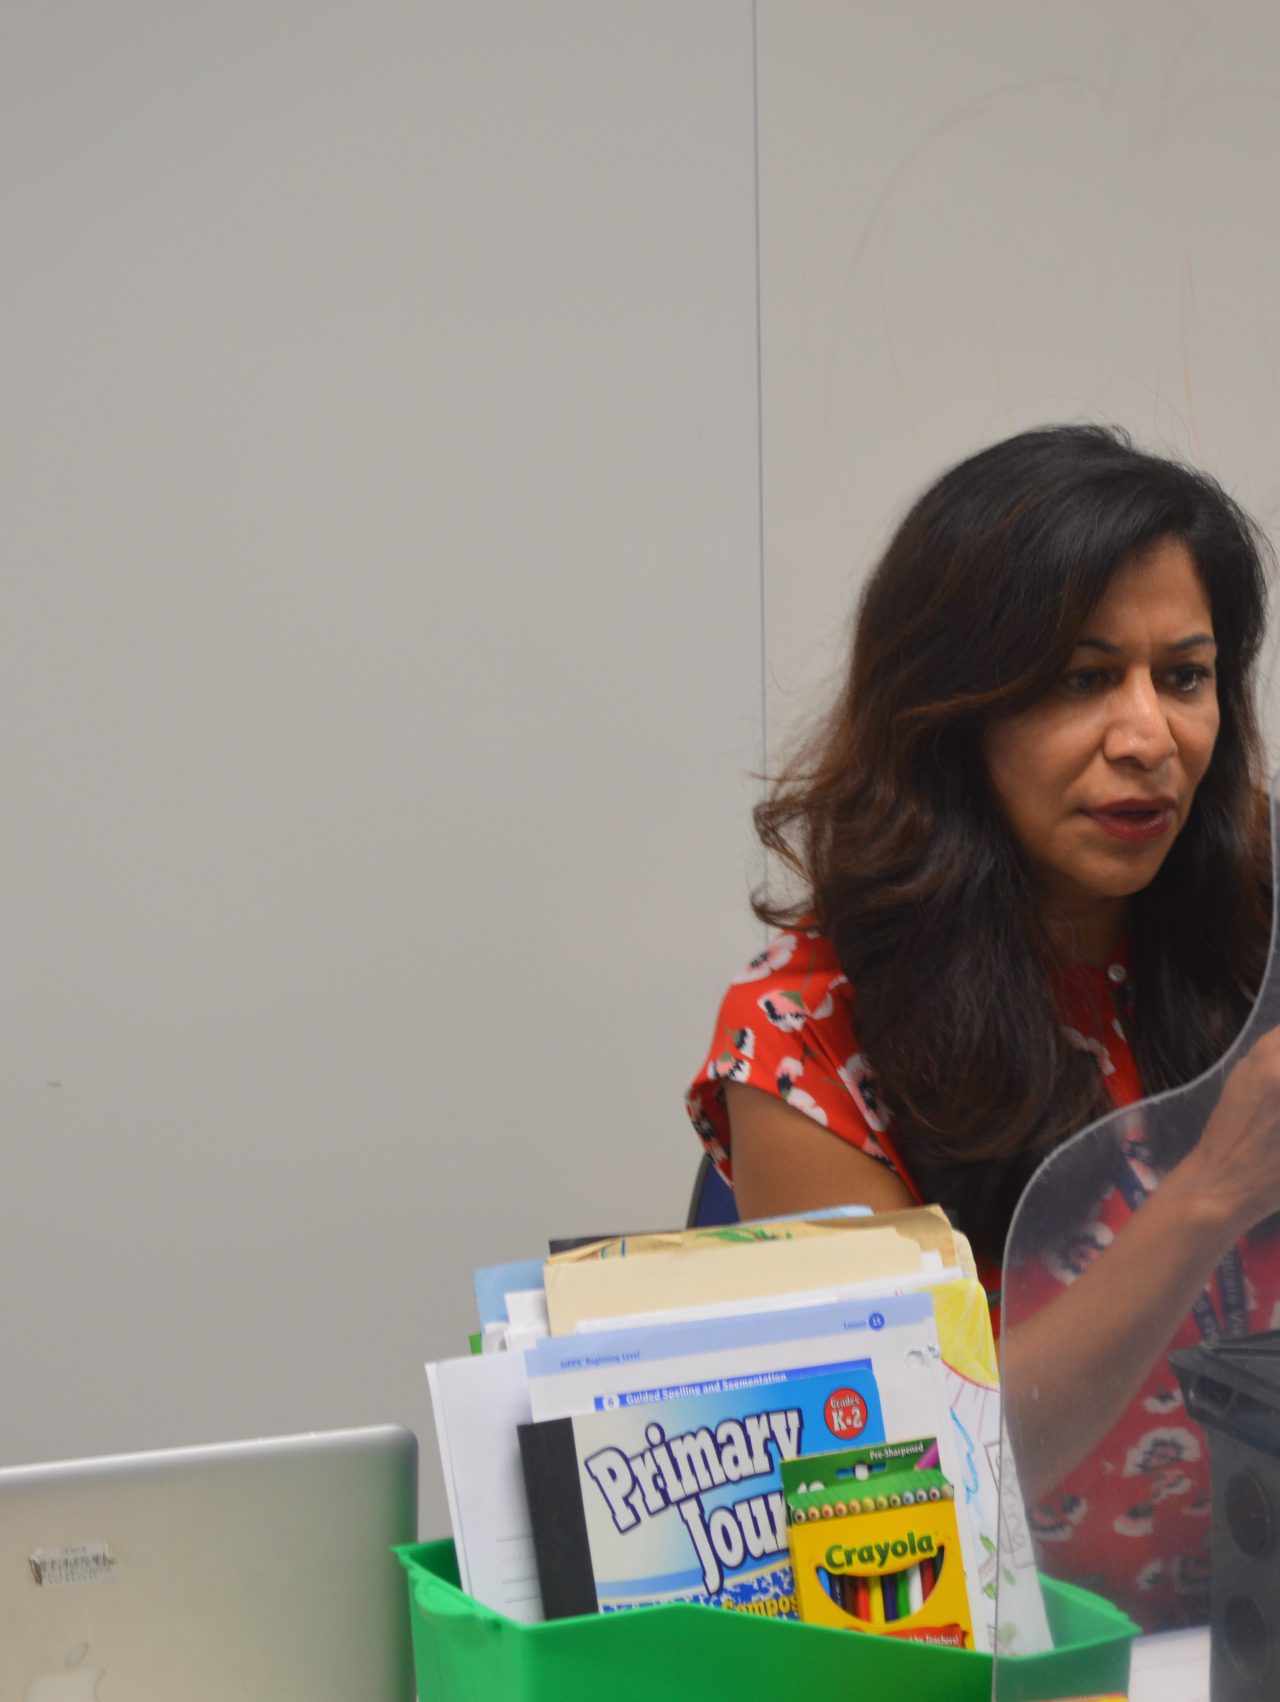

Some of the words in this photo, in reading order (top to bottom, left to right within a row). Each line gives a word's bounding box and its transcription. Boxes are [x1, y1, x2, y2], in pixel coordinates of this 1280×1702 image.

[620, 1350, 640, 1361] Level
[625, 1388, 660, 1406] Guided
[662, 1384, 701, 1401] Spelling
[702, 1381, 721, 1394] and
[722, 1372, 787, 1391] Segmentation
[830, 1394, 860, 1410] Grades
[831, 1406, 863, 1432] K-2
[869, 1441, 924, 1461] Pre-Sharpened
[584, 1407, 803, 1535] Primary
[677, 1489, 789, 1596] Jour
[825, 1531, 934, 1569] Crayola
